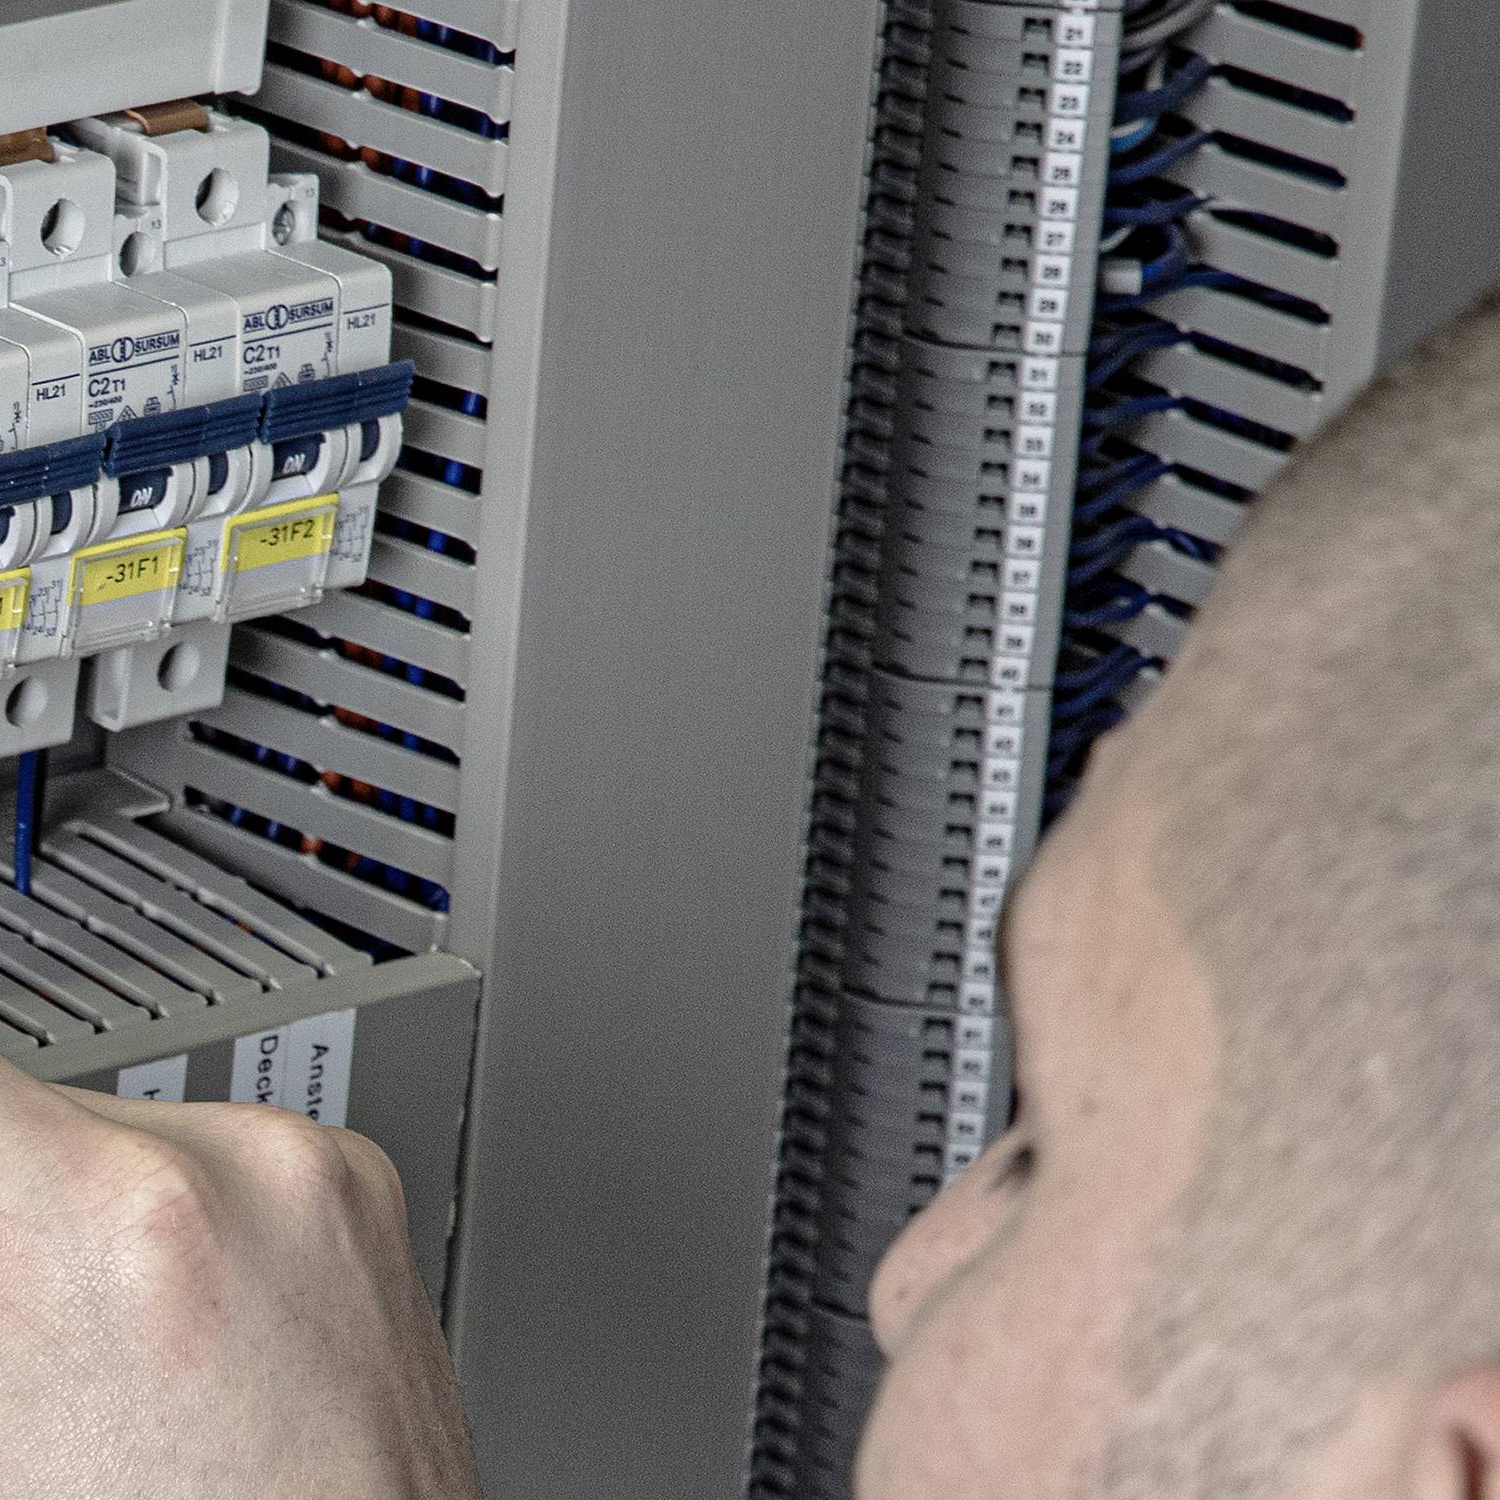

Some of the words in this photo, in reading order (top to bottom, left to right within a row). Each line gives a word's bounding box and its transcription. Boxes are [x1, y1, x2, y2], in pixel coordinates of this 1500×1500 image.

[243, 314, 265, 330] ABL
[289, 298, 334, 323] SURSUM
[347, 315, 376, 329] HL21
[89, 348, 111, 364] ABL
[134, 332, 179, 356] SURSUM
[194, 346, 222, 362] HL21
[36, 384, 66, 401] HL21
[260, 519, 314, 547] -31F2
[106, 557, 159, 583] -31F1
